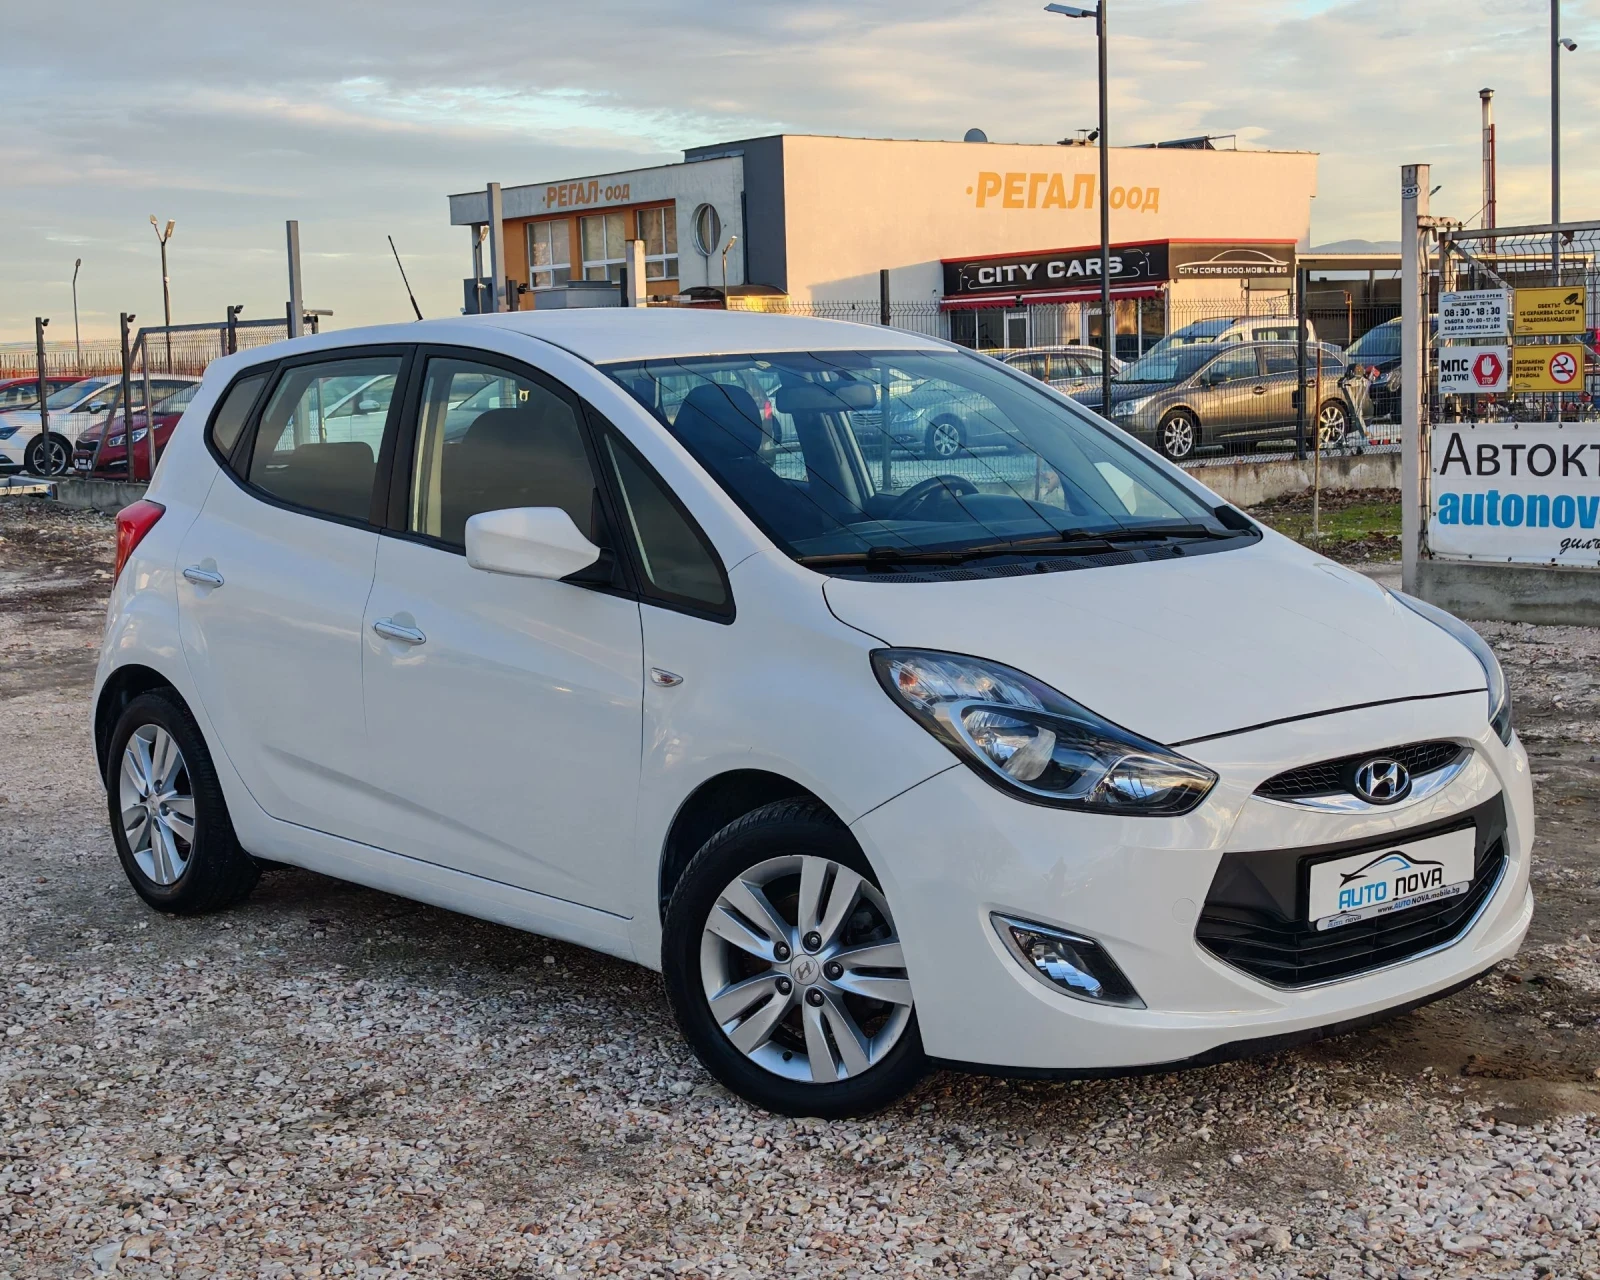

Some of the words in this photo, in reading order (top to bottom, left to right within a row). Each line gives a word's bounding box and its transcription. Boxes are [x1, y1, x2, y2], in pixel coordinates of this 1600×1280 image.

[546, 180, 599, 208] РЕГАЛ
[975, 172, 1096, 209] РЕГАЛ
[978, 263, 1039, 284] CITY
[1047, 256, 1123, 278] CARS
[1441, 359, 1469, 372] МПС
[1481, 377, 1494, 385] STOP
[1438, 489, 1600, 529] autonov
[1338, 881, 1387, 909] AUTO
[1395, 867, 1443, 896] NOVA
